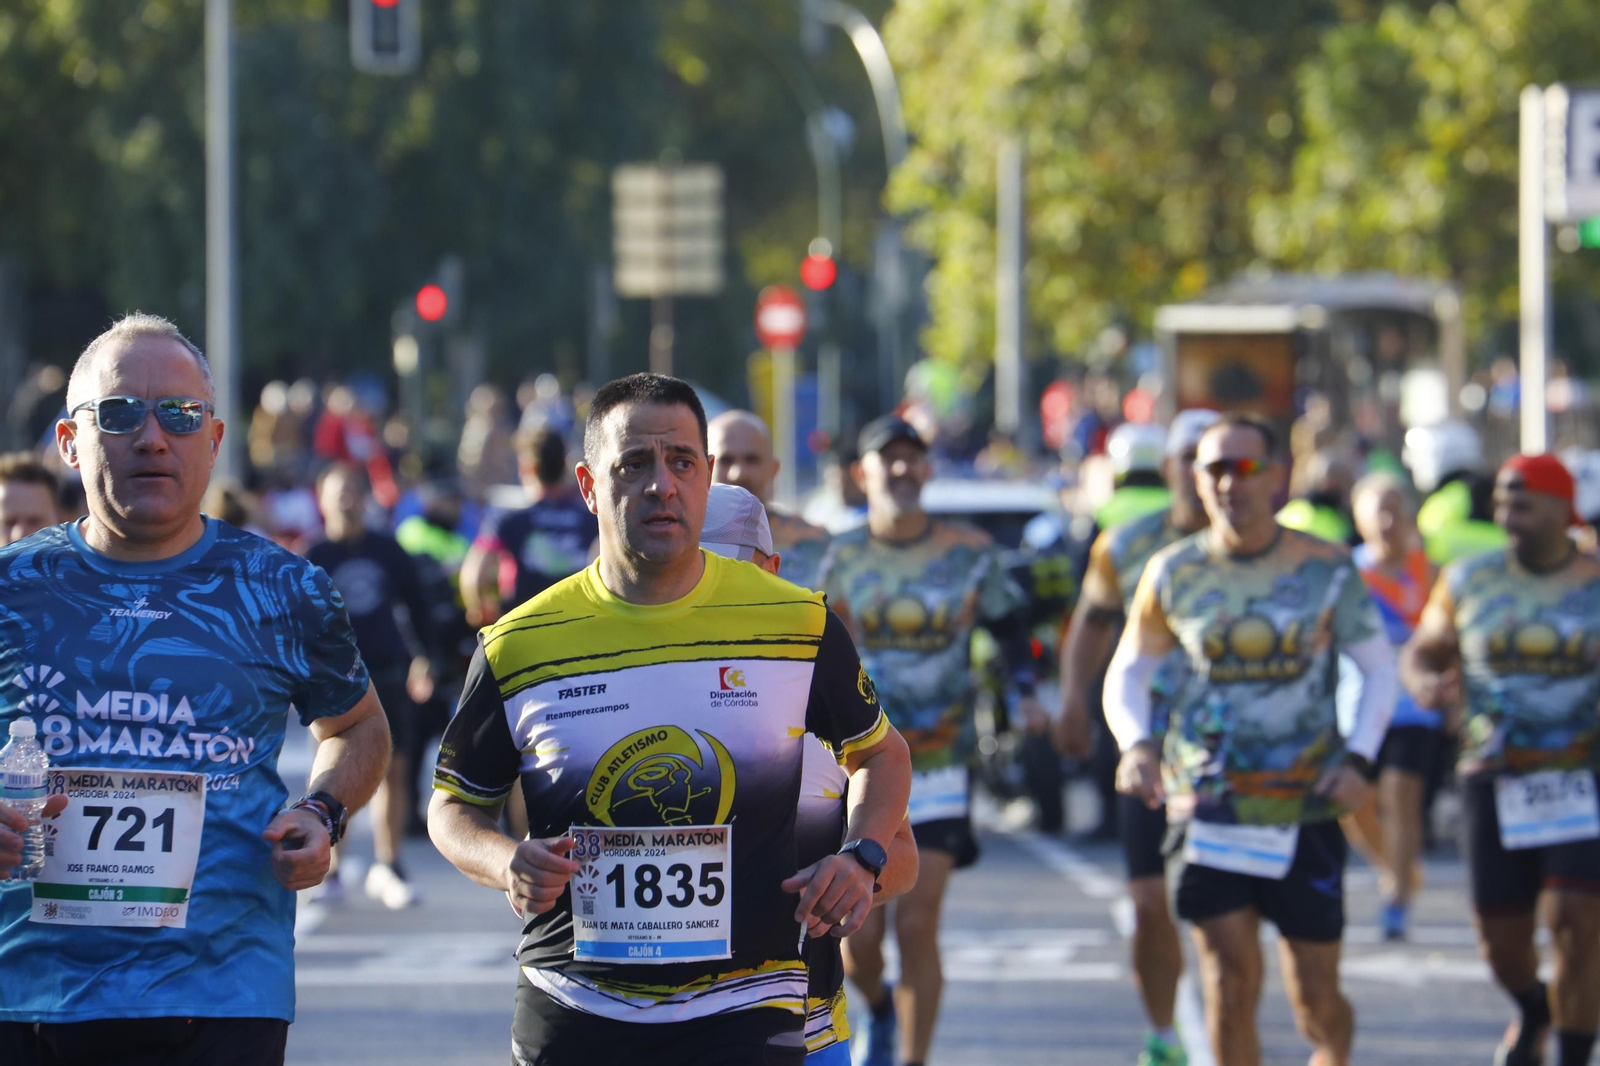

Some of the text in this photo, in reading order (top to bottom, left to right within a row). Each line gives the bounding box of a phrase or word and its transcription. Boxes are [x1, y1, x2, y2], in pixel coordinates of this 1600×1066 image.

[109, 608, 172, 619] TEAMERGY
[558, 684, 606, 700] FASTER
[710, 690, 757, 701] Diputación
[76, 690, 196, 726] MEDIA
[545, 702, 630, 722] #teamperezcampos
[711, 699, 759, 708] de Córdoba
[78, 726, 254, 764] MARATÓN
[607, 730, 668, 776] ATLETISMO
[69, 774, 198, 792] MEDIA MARATÓN
[204, 772, 239, 791] 2024
[113, 790, 136, 799] 2024
[590, 776, 610, 806] CLUB
[83, 806, 175, 853] 721
[604, 829, 724, 847] MEDIA MARATÓN
[574, 832, 601, 858] 38
[644, 848, 666, 857] 2024
[67, 863, 155, 874] JOSE FRANCO RAMOS
[88, 887, 123, 900] CAJÓN 3
[606, 862, 725, 909] 1835
[582, 919, 720, 931] JUAN DE MATA CABALLERO SANCHEZ
[628, 943, 662, 957] CAJÓN 4
